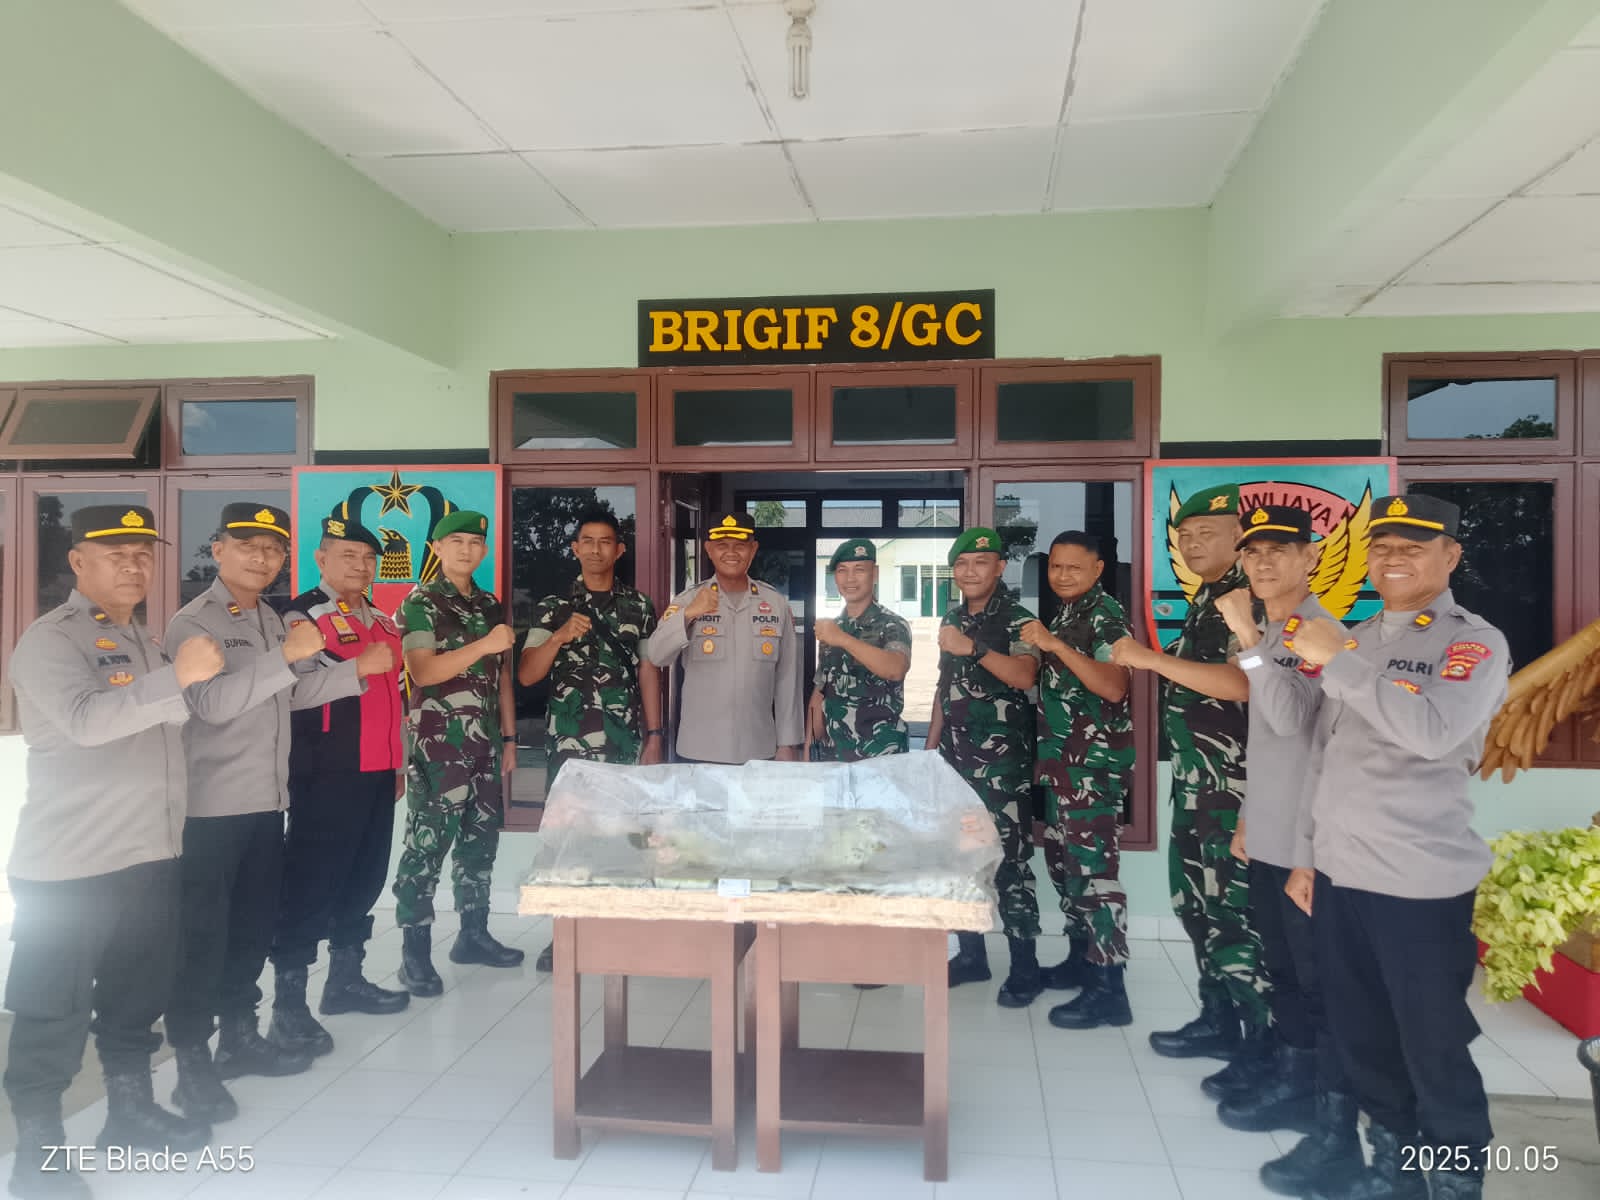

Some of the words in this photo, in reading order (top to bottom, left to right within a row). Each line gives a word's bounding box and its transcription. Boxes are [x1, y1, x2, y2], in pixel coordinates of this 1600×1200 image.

[649, 307, 838, 352] BRIGIF
[850, 301, 983, 350] 8/GC
[752, 615, 780, 624] POLRI
[1387, 658, 1433, 676] POLRI
